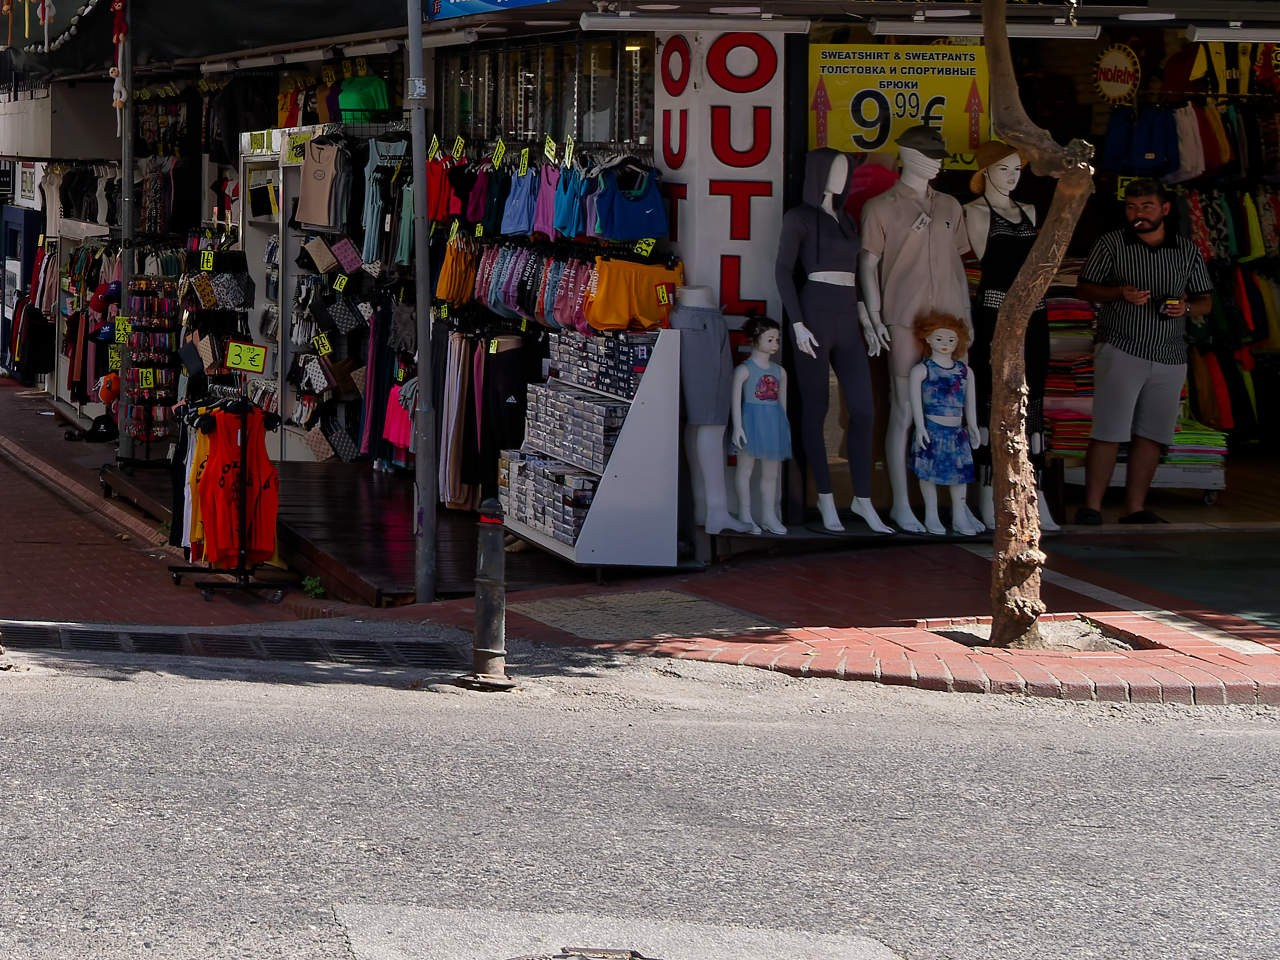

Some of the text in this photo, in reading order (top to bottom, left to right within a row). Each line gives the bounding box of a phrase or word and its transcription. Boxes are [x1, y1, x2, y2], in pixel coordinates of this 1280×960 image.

[821, 51, 976, 62] SWEATSHIRT & SWEATPANTS
[820, 65, 977, 76] ТОЛСТОВКА И СПОРТИВНЫЕ
[879, 80, 919, 89] БРЮКИ
